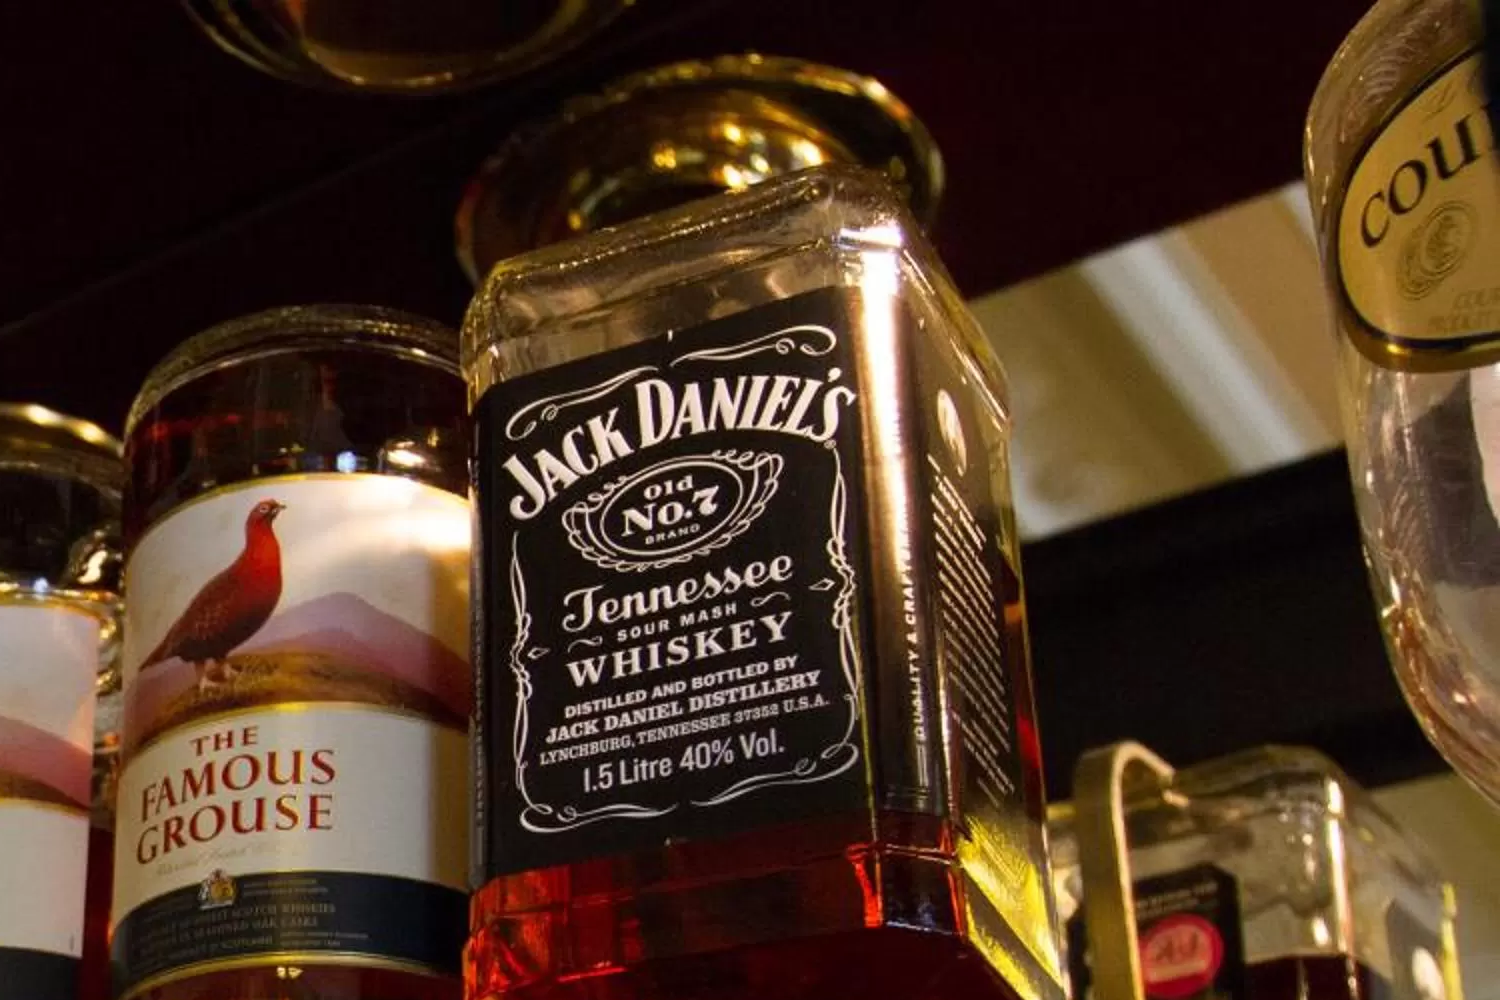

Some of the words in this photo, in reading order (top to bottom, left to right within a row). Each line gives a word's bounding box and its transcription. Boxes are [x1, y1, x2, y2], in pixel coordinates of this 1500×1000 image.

[1360, 107, 1488, 249] COU
[502, 407, 635, 522] JACK
[635, 367, 857, 443] DANIEL'S
[643, 475, 695, 501] Old
[644, 522, 702, 545] BRAND
[562, 555, 794, 633] Tennessee
[616, 619, 671, 643] SOUR
[679, 602, 739, 628] MASH
[565, 611, 794, 688] WHISKEY
[544, 717, 601, 745] JACK
[603, 701, 684, 732] DANIEL
[688, 670, 822, 713] DISTILLERY
[563, 689, 648, 719] DISTILLED
[651, 681, 688, 700] AND
[691, 661, 770, 690] BOTTLED
[773, 655, 799, 673] BY
[190, 725, 261, 757] THE
[582, 762, 614, 793] 1.5
[618, 752, 674, 786] Litre
[679, 736, 735, 773] 40%
[739, 727, 786, 761] Vol.
[636, 712, 732, 746] TENNESSEE
[140, 748, 337, 824] FAMOUS
[135, 793, 335, 866] GROUSE
